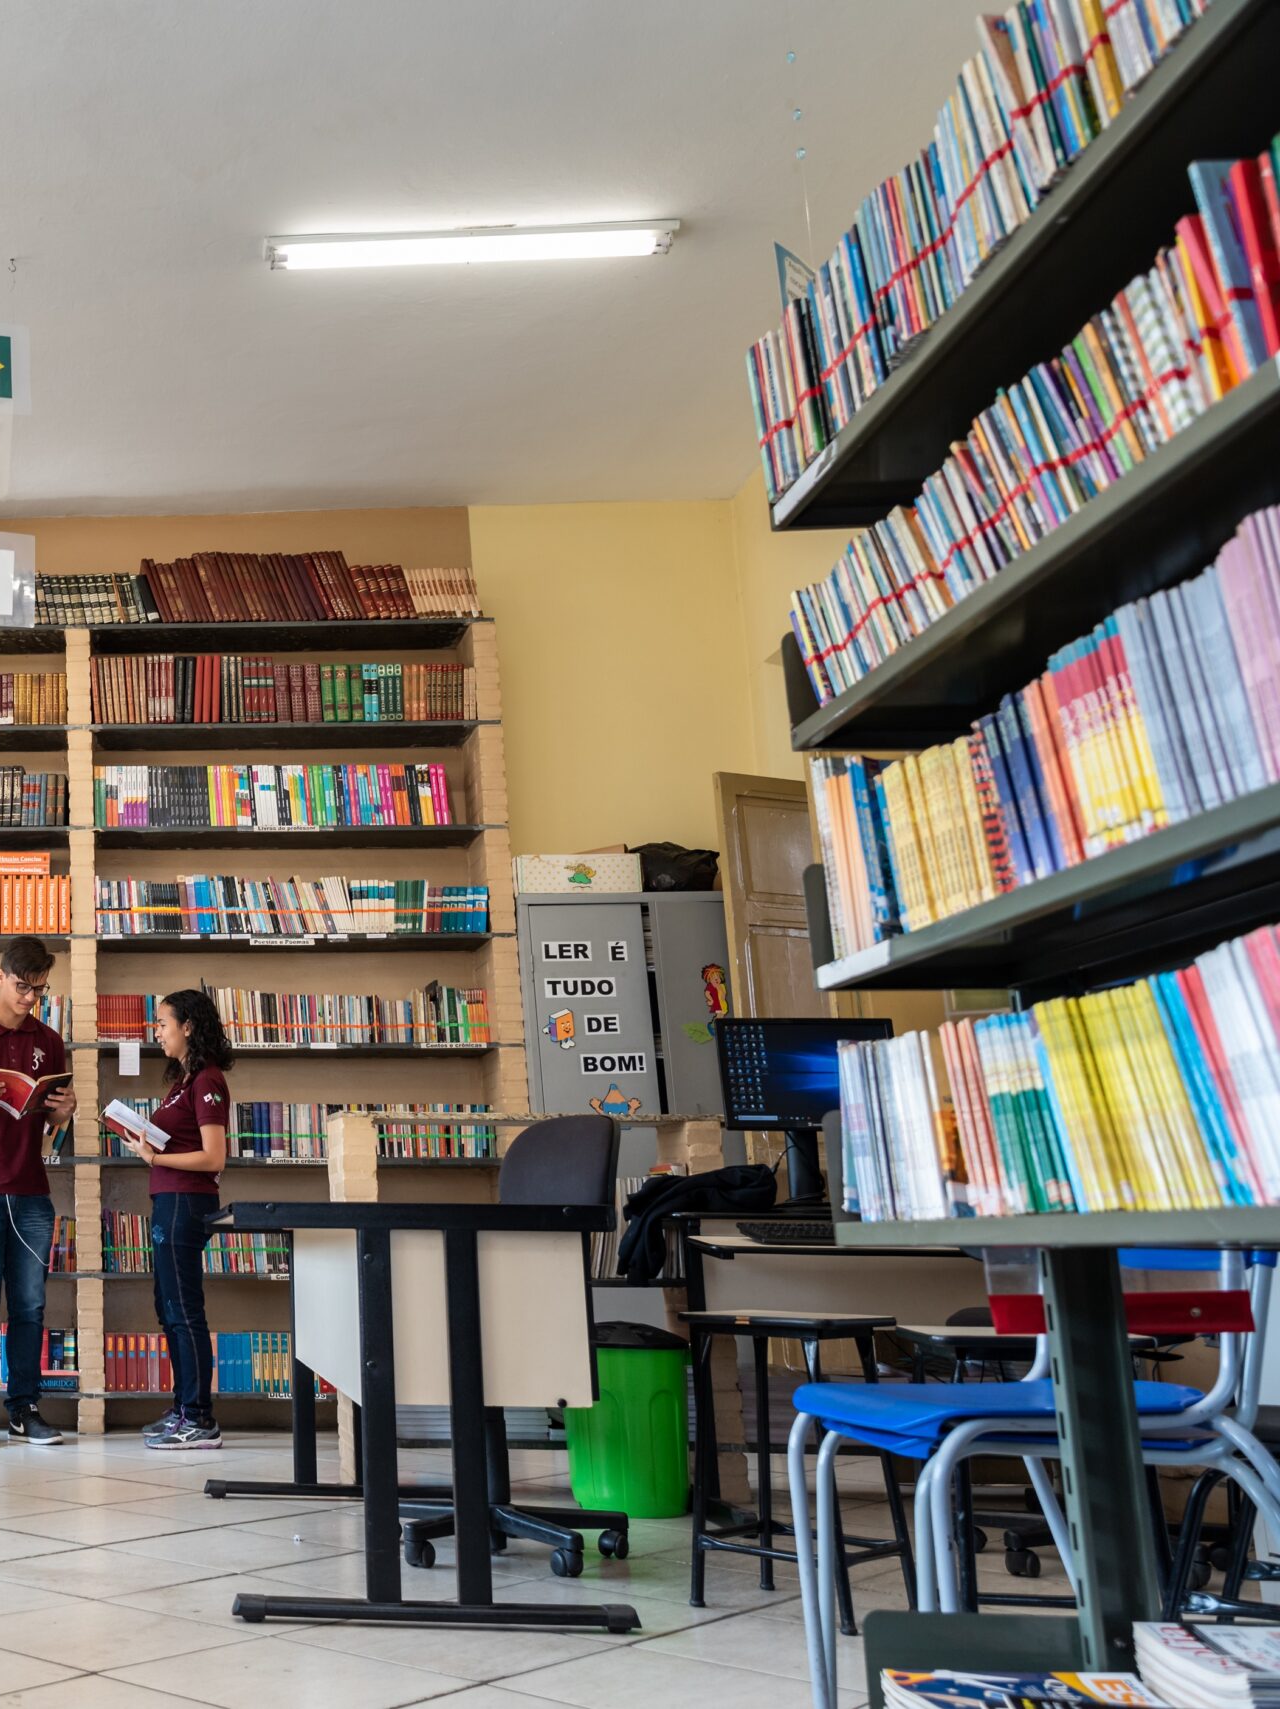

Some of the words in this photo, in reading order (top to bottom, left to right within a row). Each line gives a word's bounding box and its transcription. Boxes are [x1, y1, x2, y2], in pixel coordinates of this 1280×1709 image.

[544, 944, 589, 959] LER
[611, 942, 625, 960] É
[547, 980, 613, 996] TUDO
[587, 1017, 618, 1032] DE
[583, 1056, 644, 1072] BOM!
